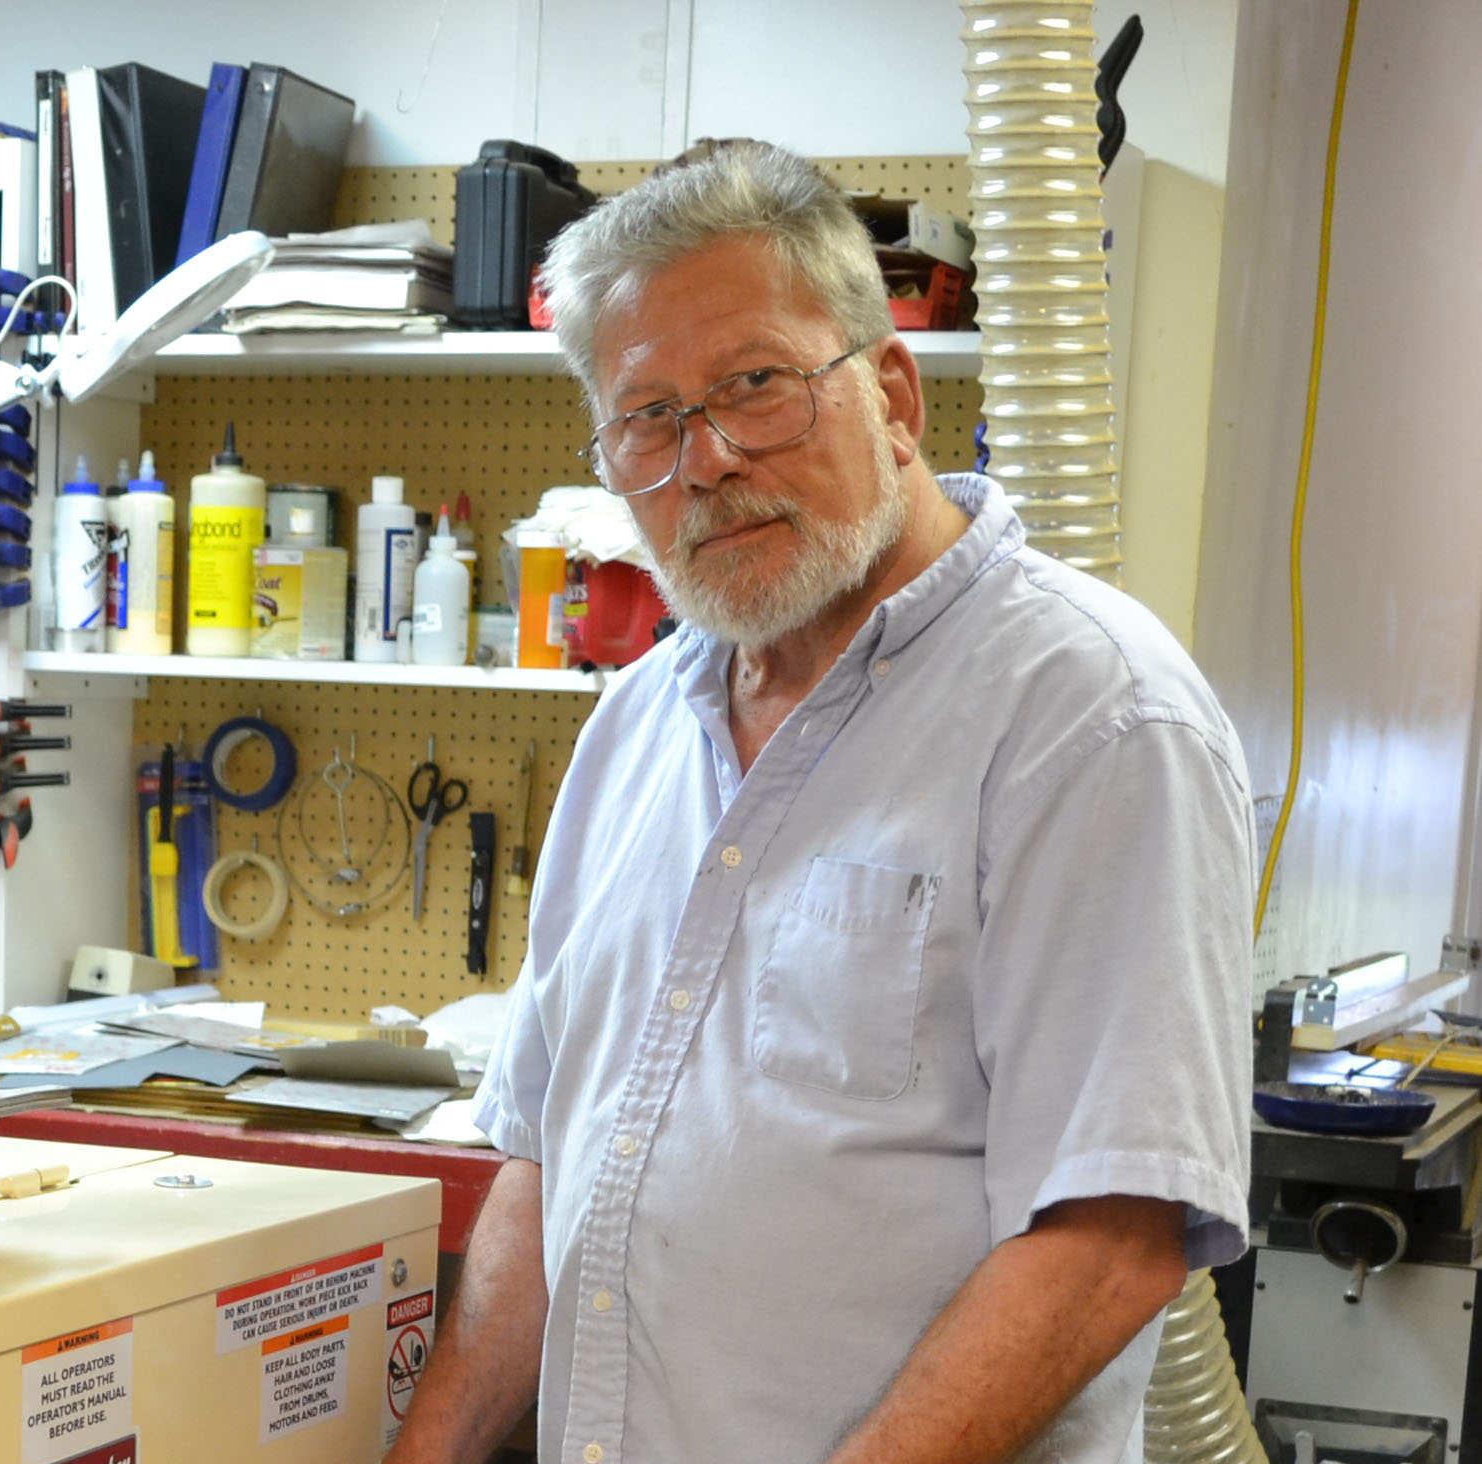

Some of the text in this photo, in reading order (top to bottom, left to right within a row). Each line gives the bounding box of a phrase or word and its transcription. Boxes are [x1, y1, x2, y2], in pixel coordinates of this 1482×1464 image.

[225, 1263, 375, 1320] DO NOT STAND IN FRONT OF OR BEHIND MACHINE
[233, 1314, 258, 1331] DURING
[299, 1296, 317, 1311] WORK
[318, 1290, 336, 1304] PIECE
[338, 1285, 351, 1299] KICK
[353, 1279, 368, 1294] BACK
[242, 1328, 256, 1341] CAN
[257, 1321, 278, 1337] CAUSE
[280, 1311, 305, 1331] SERIOUS
[307, 1304, 327, 1321] INJURY
[329, 1301, 338, 1313] OR
[390, 1296, 428, 1323] DANGER
[64, 1330, 100, 1348] WARNING
[40, 1353, 116, 1388] ALL OPERATORS
[265, 1360, 284, 1375] KEEP
[285, 1355, 299, 1367] ALL
[301, 1348, 320, 1363] BODY
[274, 1357, 336, 1387] HAIR AND LOOSE
[41, 1371, 116, 1406] MUST READ THE
[273, 1371, 336, 1401] CLOTHING AWAY
[27, 1385, 127, 1429] OPERATOR'S MANUAL
[269, 1412, 301, 1433] MOTORS
[302, 1405, 318, 1420] AND
[279, 1399, 301, 1415] FROM
[49, 1410, 107, 1440] BEFORE USE.
